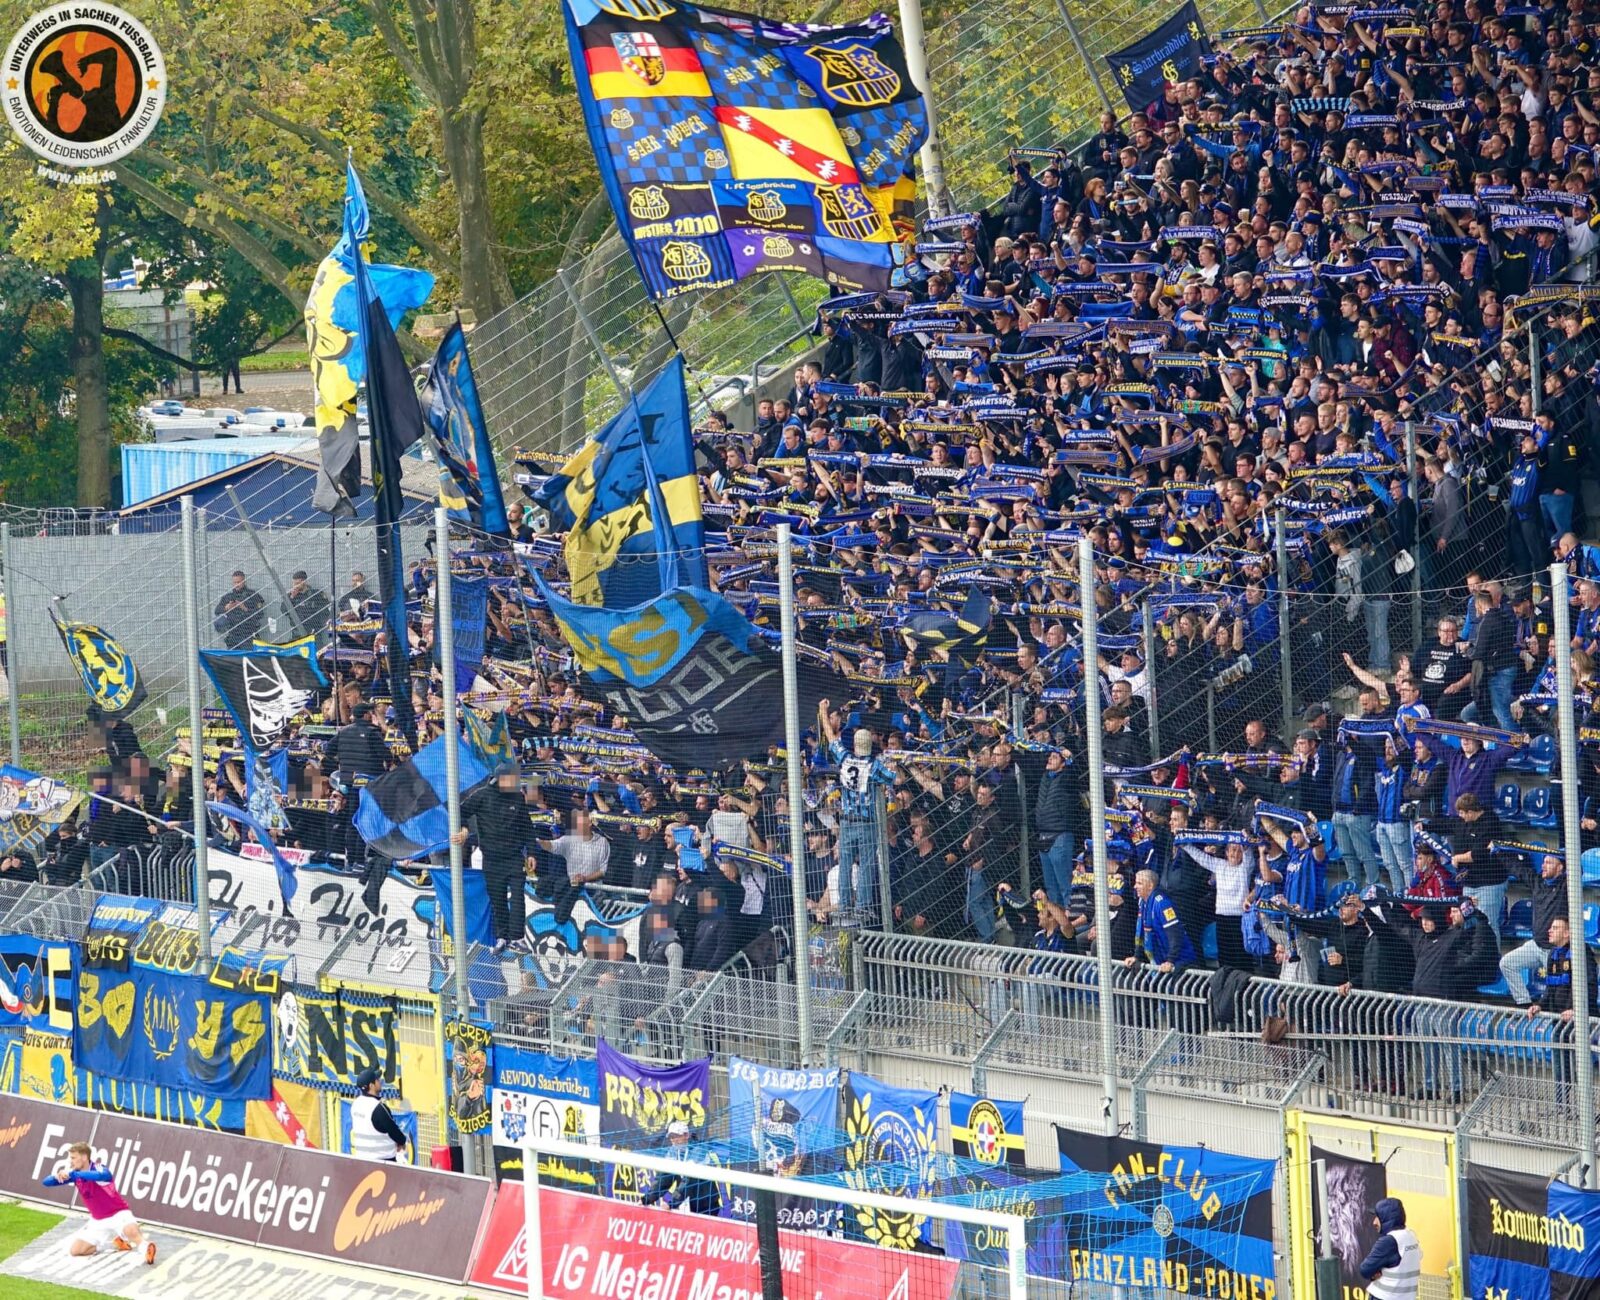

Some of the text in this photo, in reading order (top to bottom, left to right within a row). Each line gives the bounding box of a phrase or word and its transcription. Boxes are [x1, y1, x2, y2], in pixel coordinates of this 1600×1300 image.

[674, 215, 719, 236] 2010
[846, 765, 859, 785] 3
[500, 1070, 537, 1088] AEWDO
[1489, 1198, 1586, 1254] Kommando
[655, 1226, 705, 1257] NEVER
[706, 1234, 754, 1265] WORK
[552, 1243, 590, 1291] IG
[590, 1251, 686, 1300] Metall
